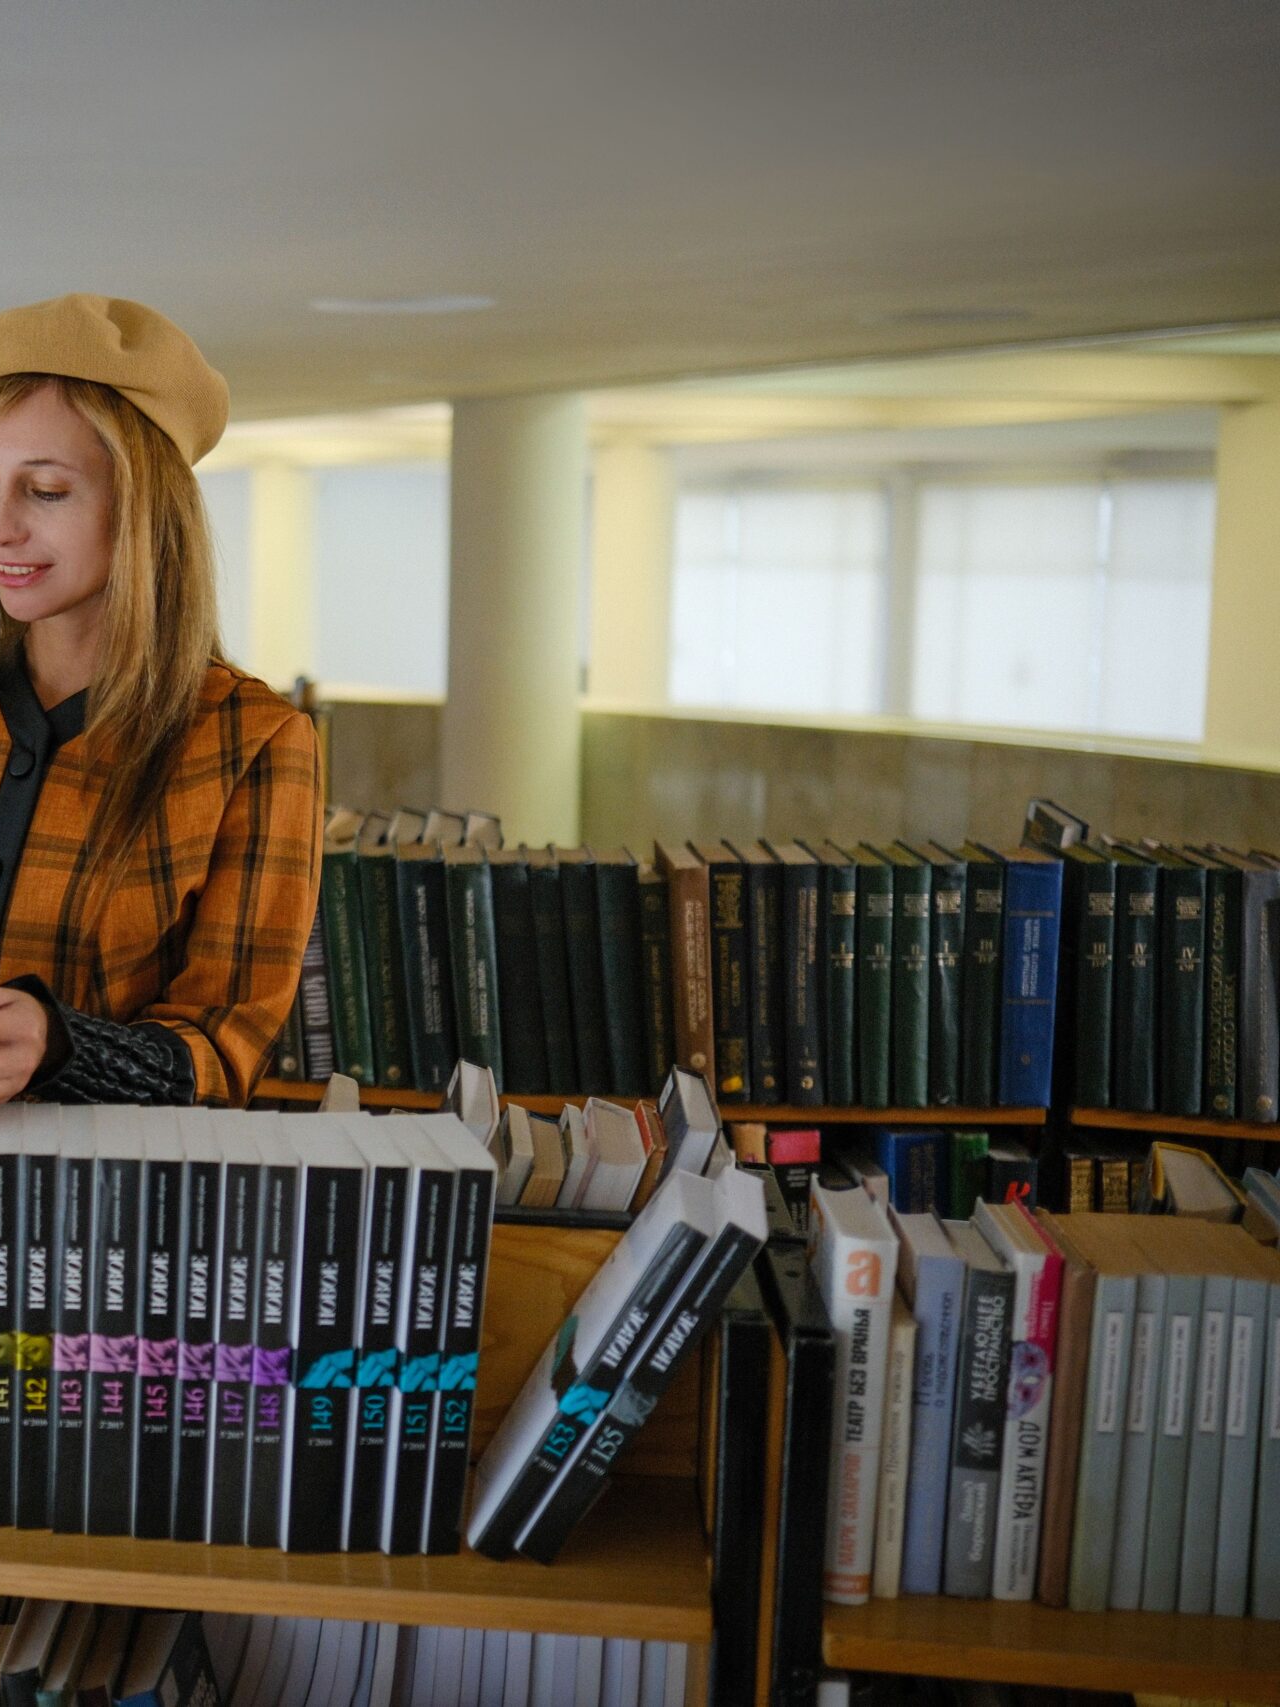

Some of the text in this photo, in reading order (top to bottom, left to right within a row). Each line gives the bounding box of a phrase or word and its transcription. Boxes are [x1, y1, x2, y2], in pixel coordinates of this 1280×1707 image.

[28, 1247, 46, 1309] НОВОЕ
[64, 1248, 83, 1310] НОВОЕ
[106, 1248, 124, 1311] НОВОЕ
[150, 1251, 169, 1315] НОВОЕ
[188, 1255, 209, 1319] НОВОЕ
[228, 1256, 248, 1320] НОВОЕ
[264, 1259, 284, 1324] НОВОЕ
[317, 1261, 339, 1326] НОВОЕ
[372, 1260, 394, 1325] НОВОЕ
[415, 1265, 438, 1330] НОВОЕ
[454, 1263, 477, 1328] НОВОЕ
[601, 1305, 650, 1368] НОВОЕ
[650, 1309, 700, 1373] НОВОЕ
[972, 1295, 994, 1400] УБЕГАЮЩЕЕ
[984, 1296, 1006, 1400] ПРОСТРАНСТВО
[25, 1378, 47, 1412] 142
[61, 1379, 82, 1414] 143
[102, 1380, 123, 1414] 144
[145, 1384, 168, 1418] 145
[184, 1387, 205, 1422] 146
[845, 1308, 871, 1442] ТЕАТР БЕЗ ВРАНЬЯ
[223, 1390, 243, 1424] 147
[258, 1392, 280, 1428] 148
[310, 1395, 333, 1431] 149
[363, 1394, 385, 1430] 150
[405, 1403, 428, 1434] 151
[444, 1400, 467, 1433] 152
[543, 1422, 576, 1460] 153
[591, 1426, 625, 1464] 155
[1018, 1421, 1041, 1458] ДОМ
[838, 1453, 862, 1567] МАРК ЗАХАРОВ
